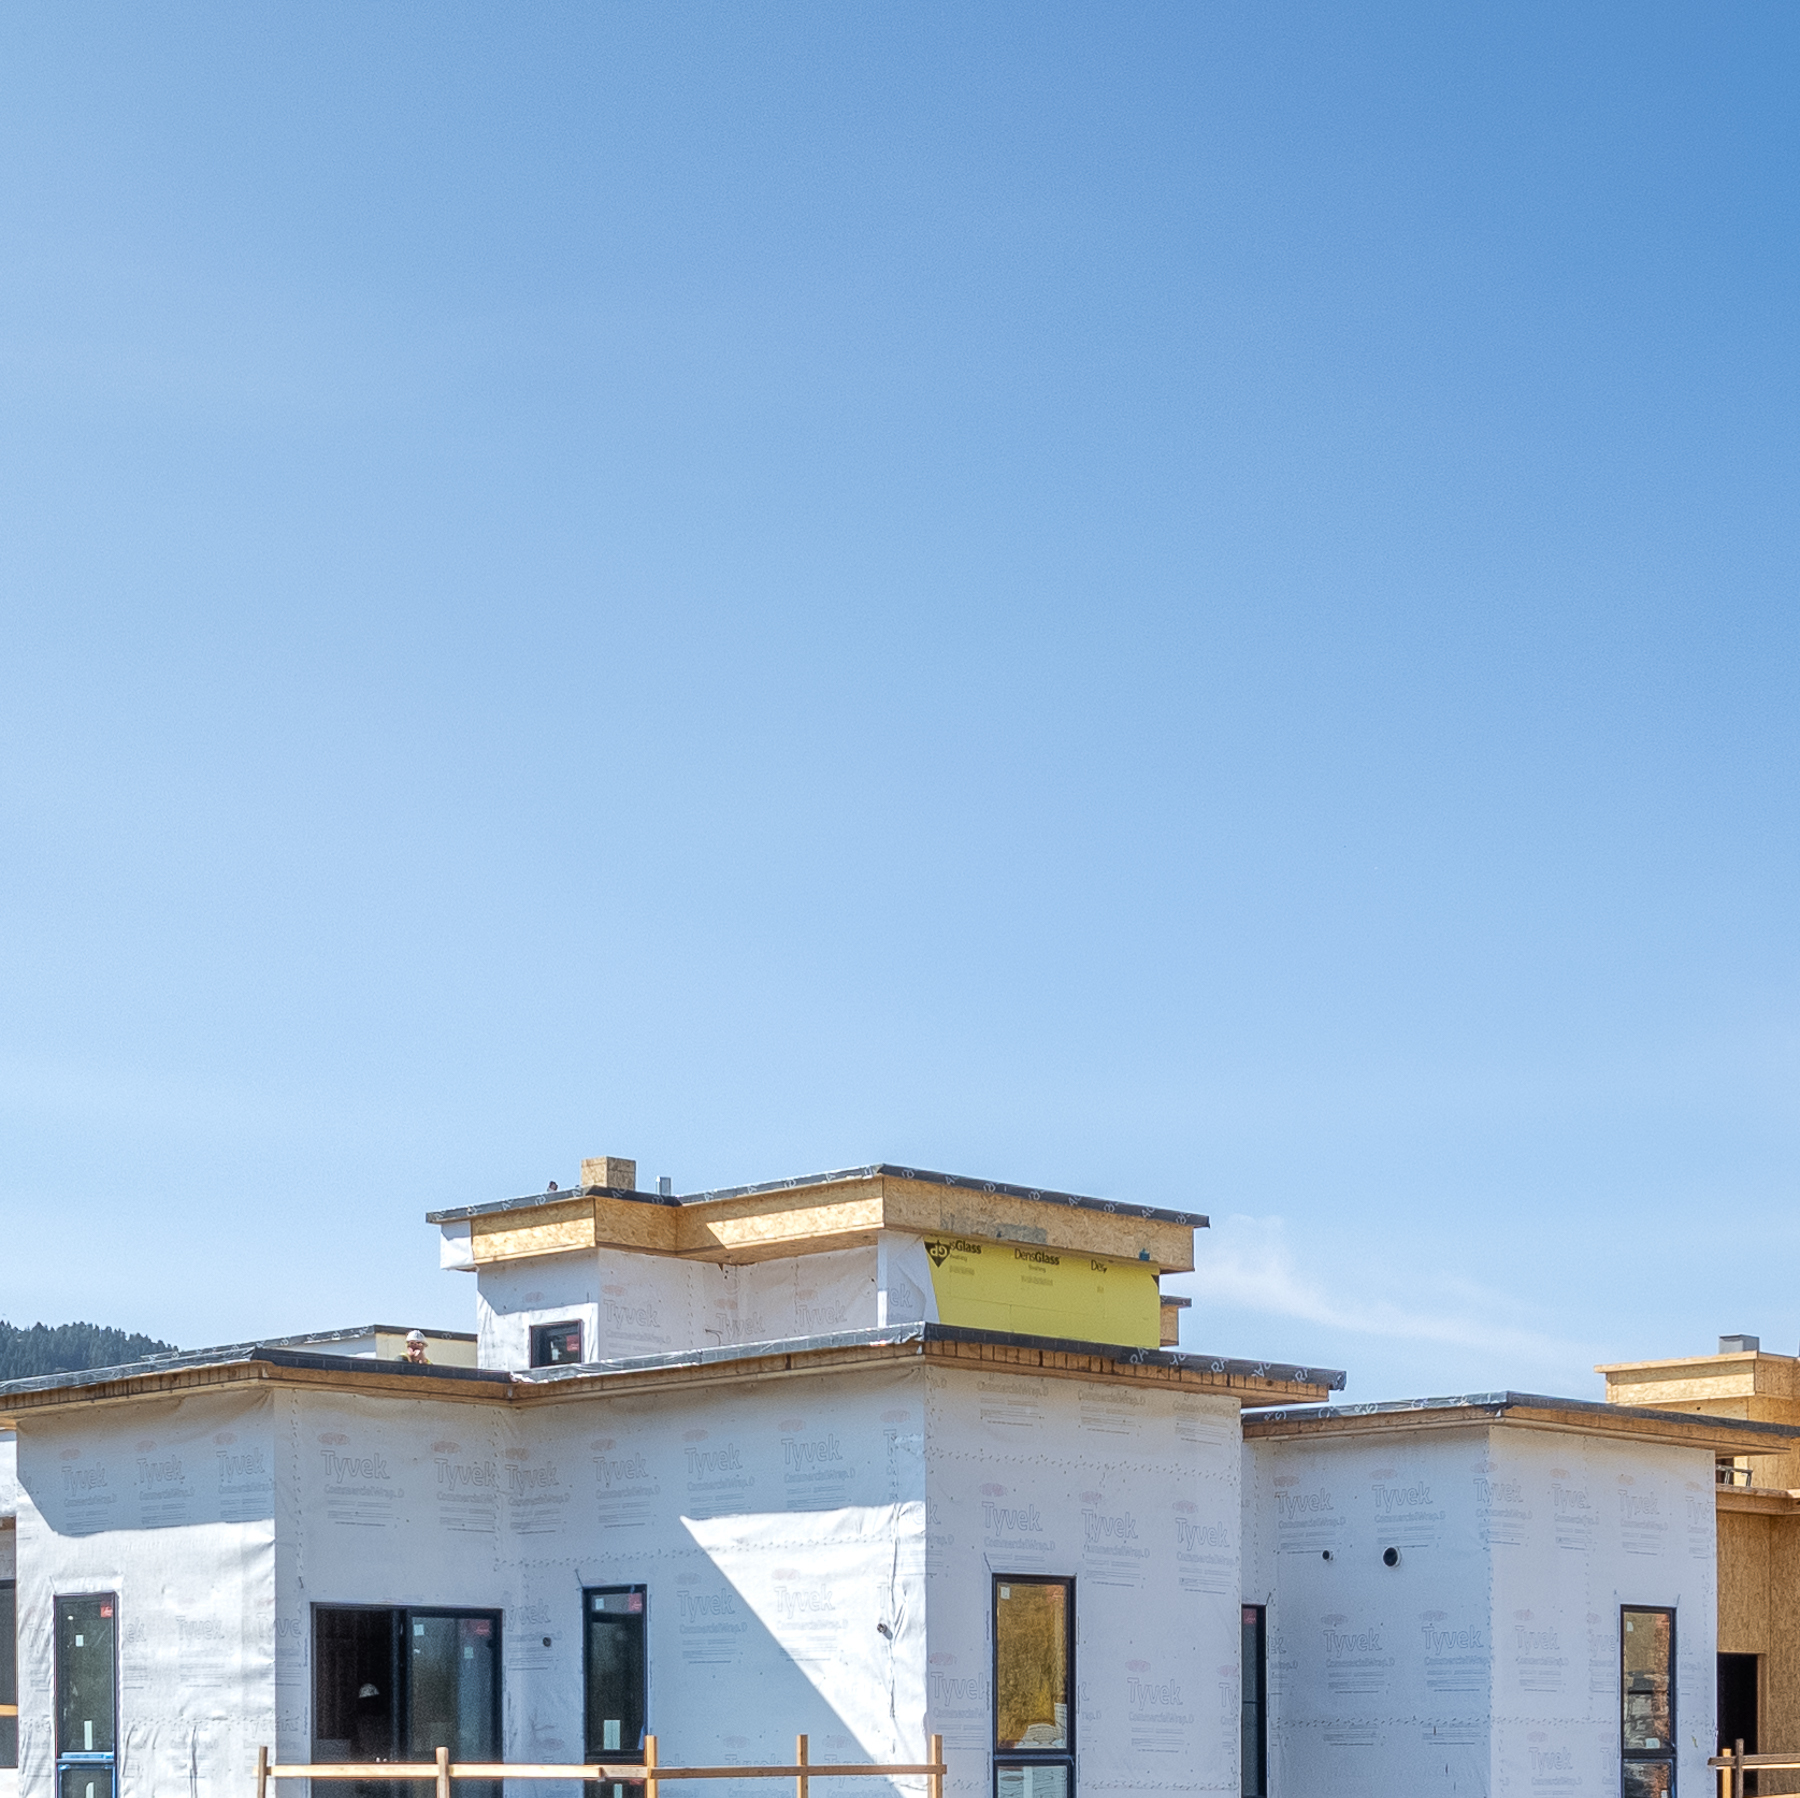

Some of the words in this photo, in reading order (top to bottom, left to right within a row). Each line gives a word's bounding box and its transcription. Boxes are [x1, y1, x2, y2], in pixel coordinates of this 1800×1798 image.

[1015, 1248, 1059, 1265] DensGlass
[684, 1444, 742, 1474] Tyvek
[781, 1436, 842, 1465] Tyvek
[320, 1450, 390, 1483] Tyvek
[1275, 1490, 1333, 1517] Tyvek
[1373, 1482, 1433, 1510] Tyvek
[982, 1501, 1043, 1536] Tyvek
[1081, 1509, 1138, 1542] Tyvek
[1176, 1517, 1229, 1551] Tyvek
[676, 1587, 735, 1617] Tyvek
[1324, 1629, 1381, 1655] Tyvek
[1422, 1624, 1485, 1653] Tyvek
[1127, 1678, 1183, 1707] Tyvek
